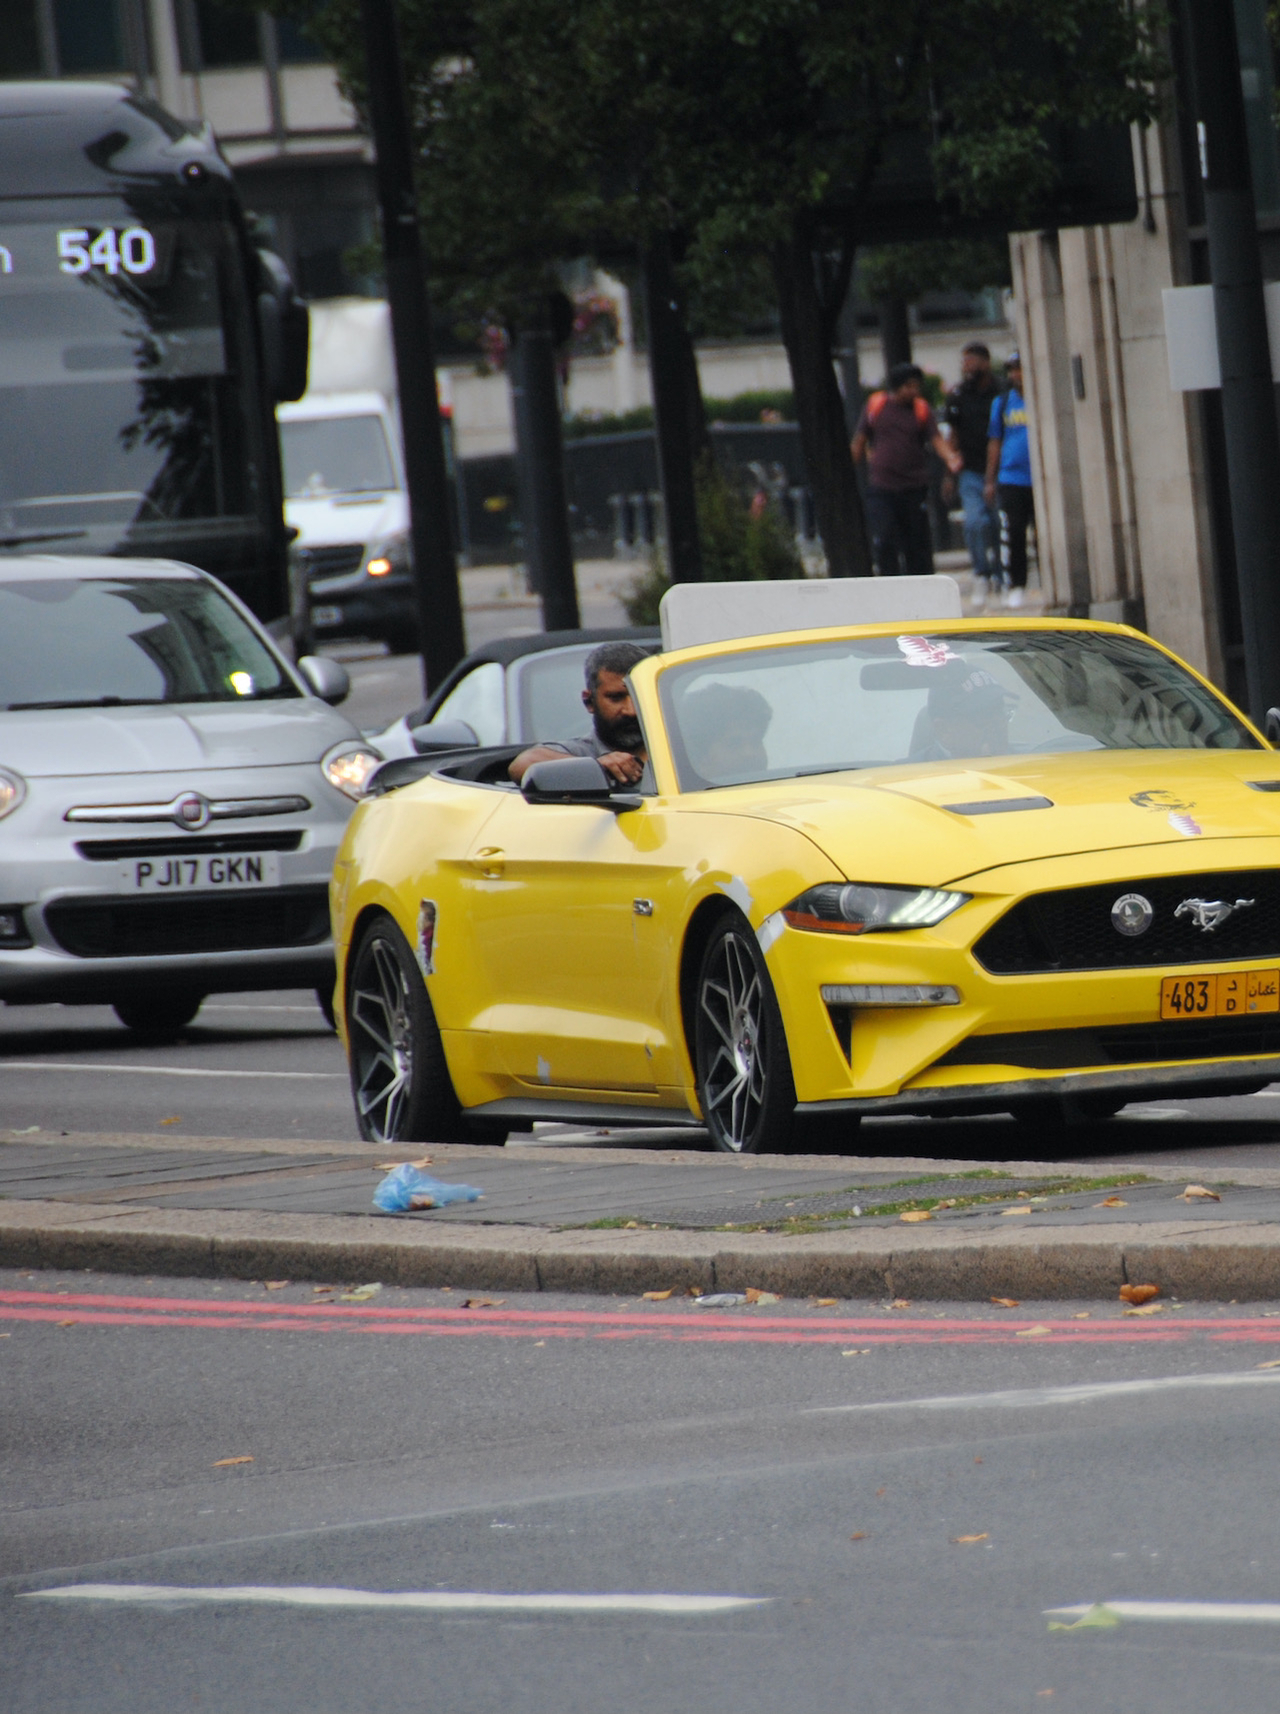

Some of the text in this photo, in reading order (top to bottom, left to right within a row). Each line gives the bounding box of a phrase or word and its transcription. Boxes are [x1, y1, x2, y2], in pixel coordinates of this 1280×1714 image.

[57, 227, 156, 274] 540
[136, 856, 263, 887] PJ17 GKN
[1171, 981, 1209, 1013] 483
[1226, 998, 1236, 1011] D
